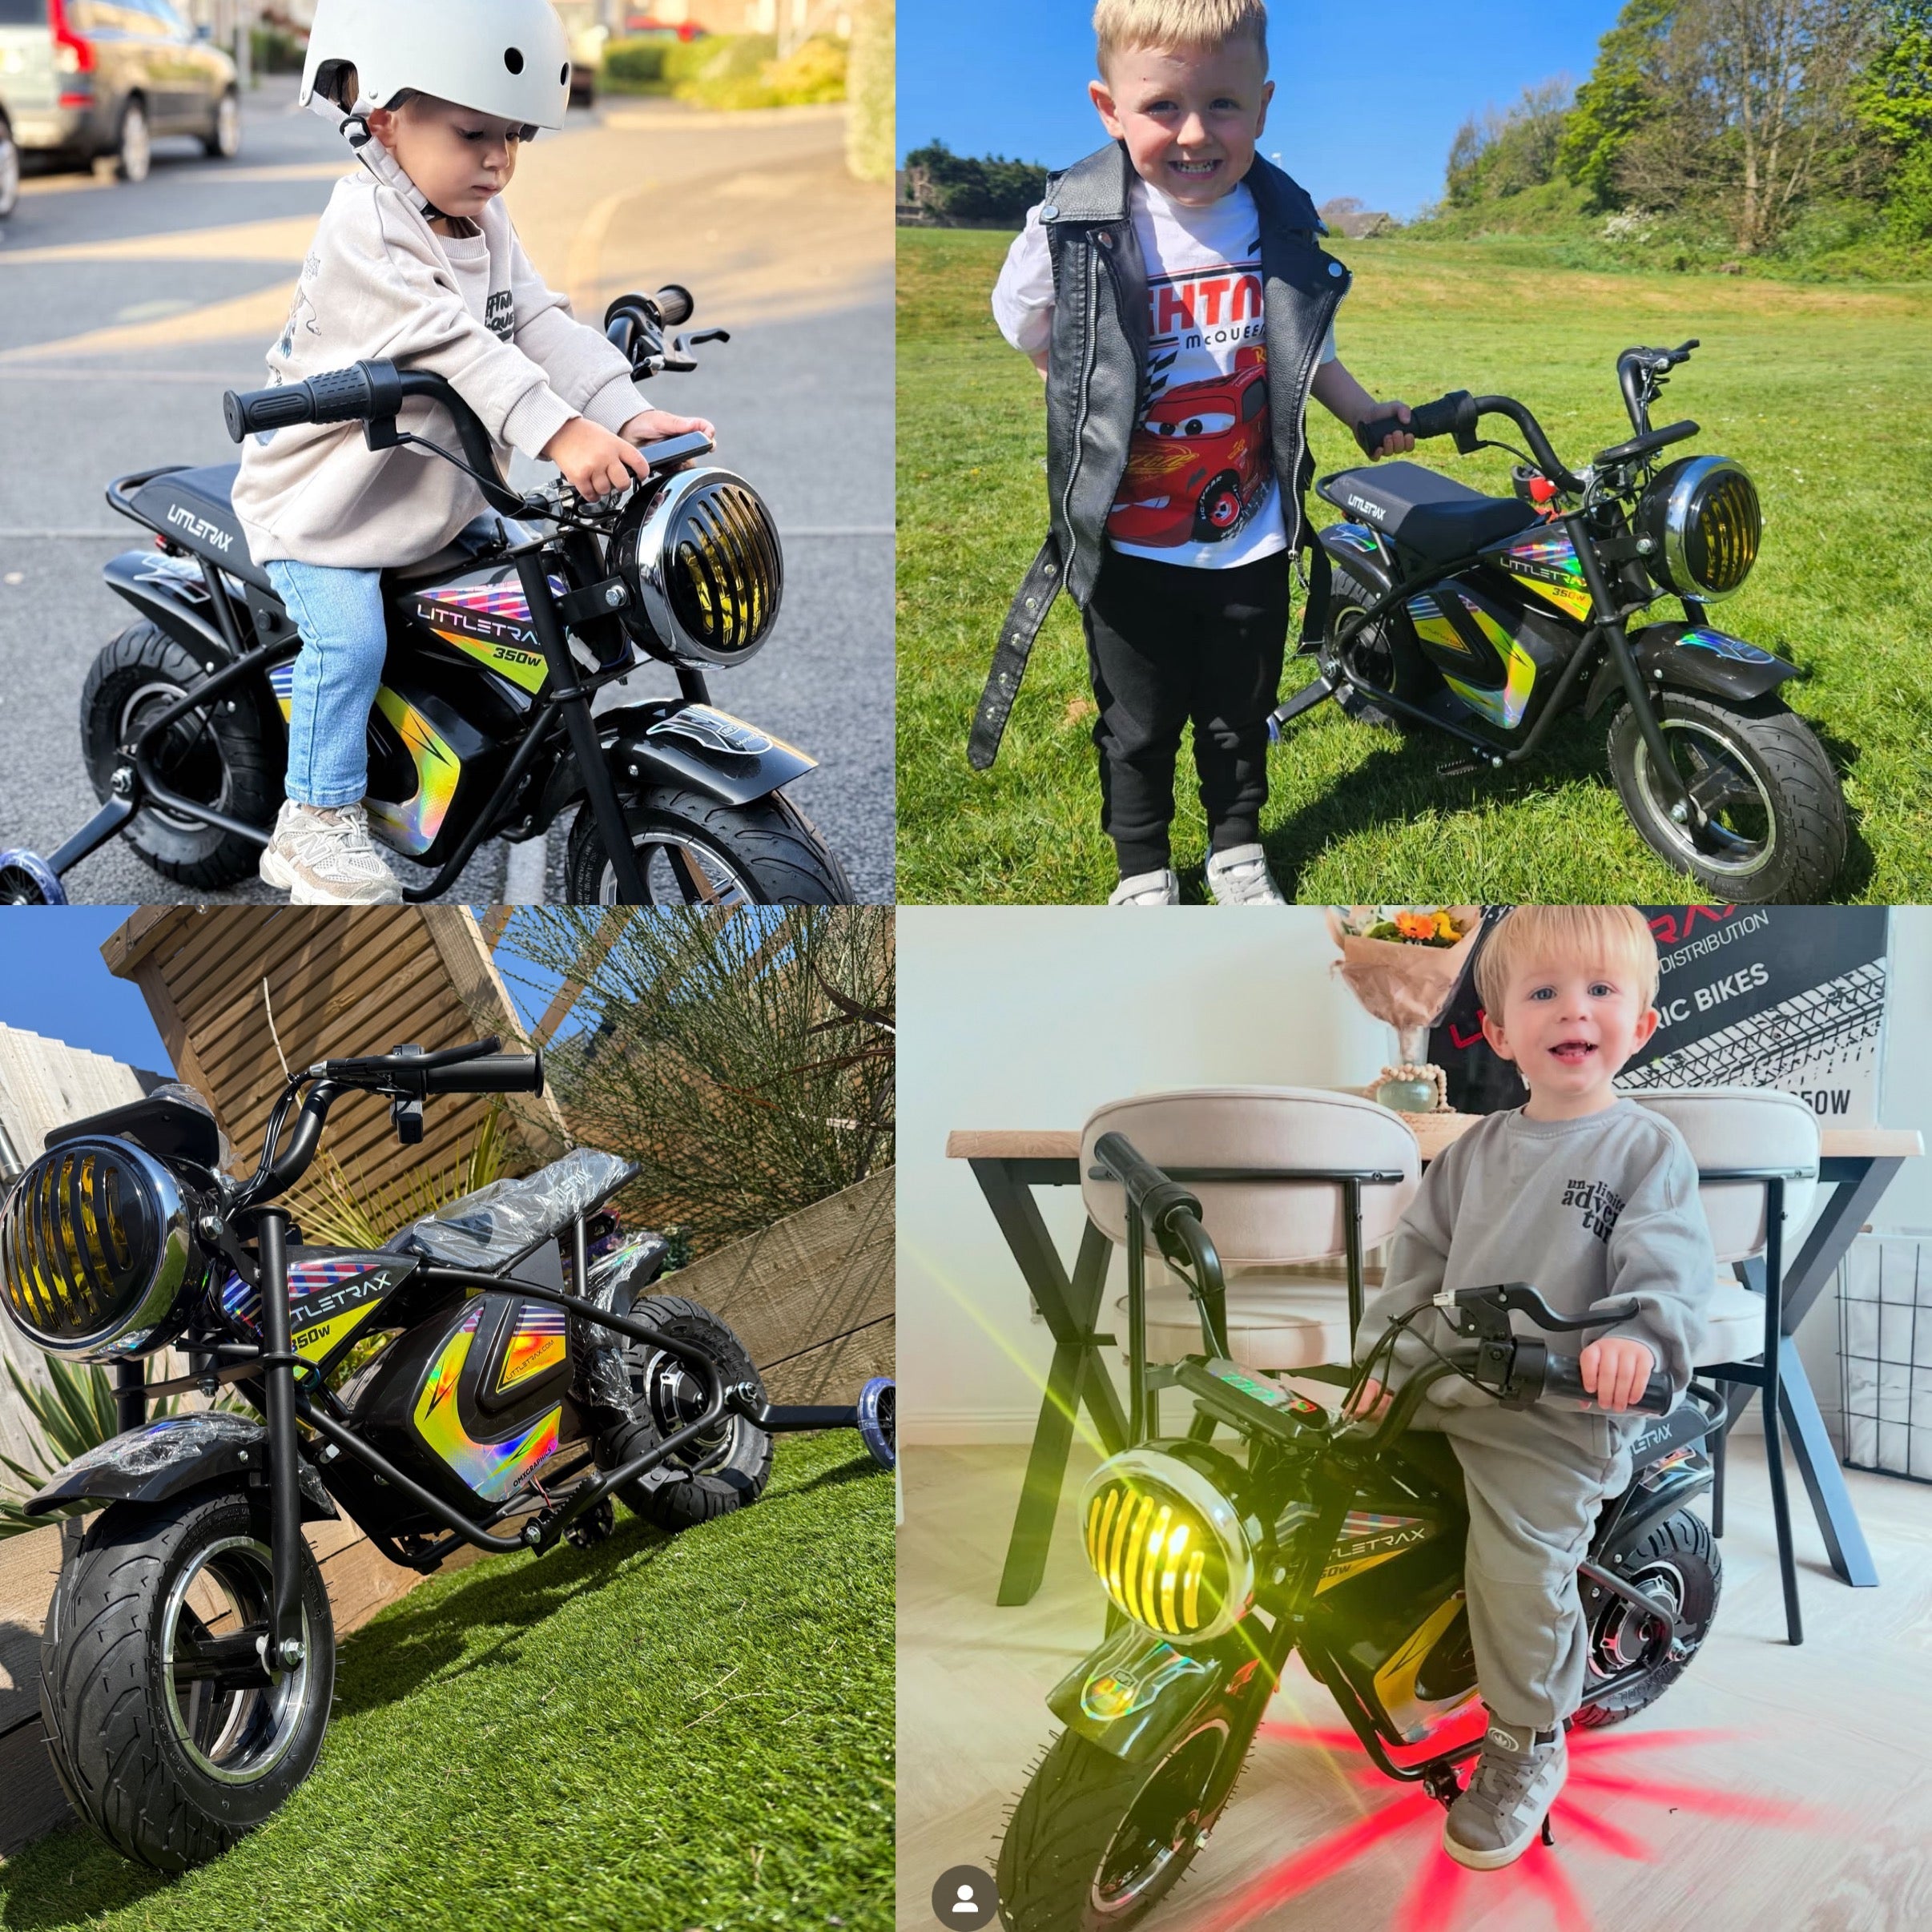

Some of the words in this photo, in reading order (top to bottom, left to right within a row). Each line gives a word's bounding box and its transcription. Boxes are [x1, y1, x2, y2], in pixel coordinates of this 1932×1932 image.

[167, 503, 234, 553] LITTLETRAX
[1347, 493, 1387, 521] LITTLETRAX
[417, 603, 541, 646] LITTLETRA
[1659, 908, 1769, 975] DISTRIBUTION
[1693, 962, 1769, 1012] BIKES
[1789, 1089, 1851, 1115] 50W
[513, 1447, 553, 1488] OMXGRAPHICS
